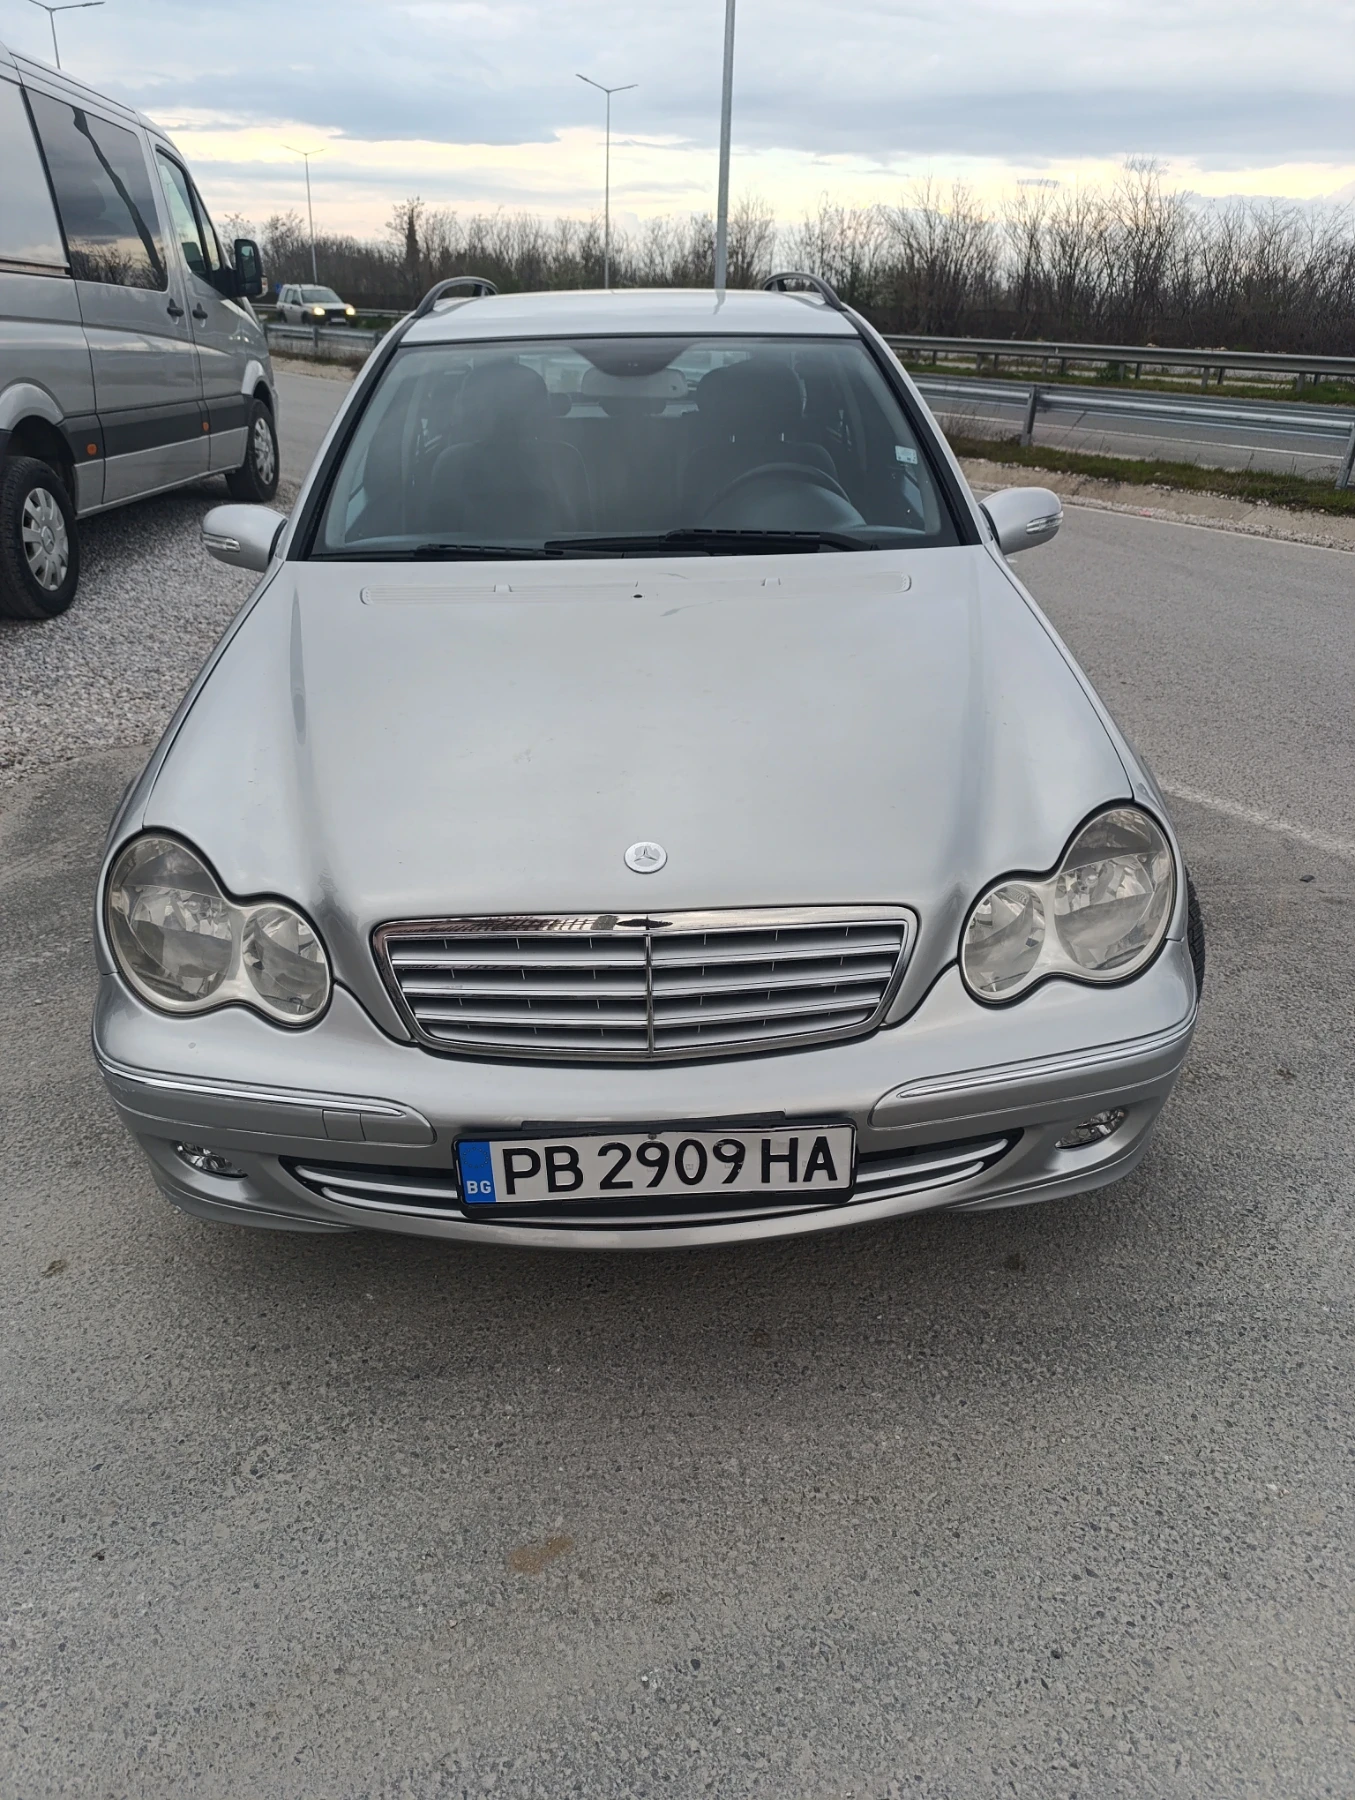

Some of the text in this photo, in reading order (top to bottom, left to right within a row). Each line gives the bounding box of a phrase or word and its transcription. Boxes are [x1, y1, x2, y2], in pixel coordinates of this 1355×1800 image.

[502, 1136, 838, 1195] PB 2909 HA
[466, 1180, 492, 1194] BG
